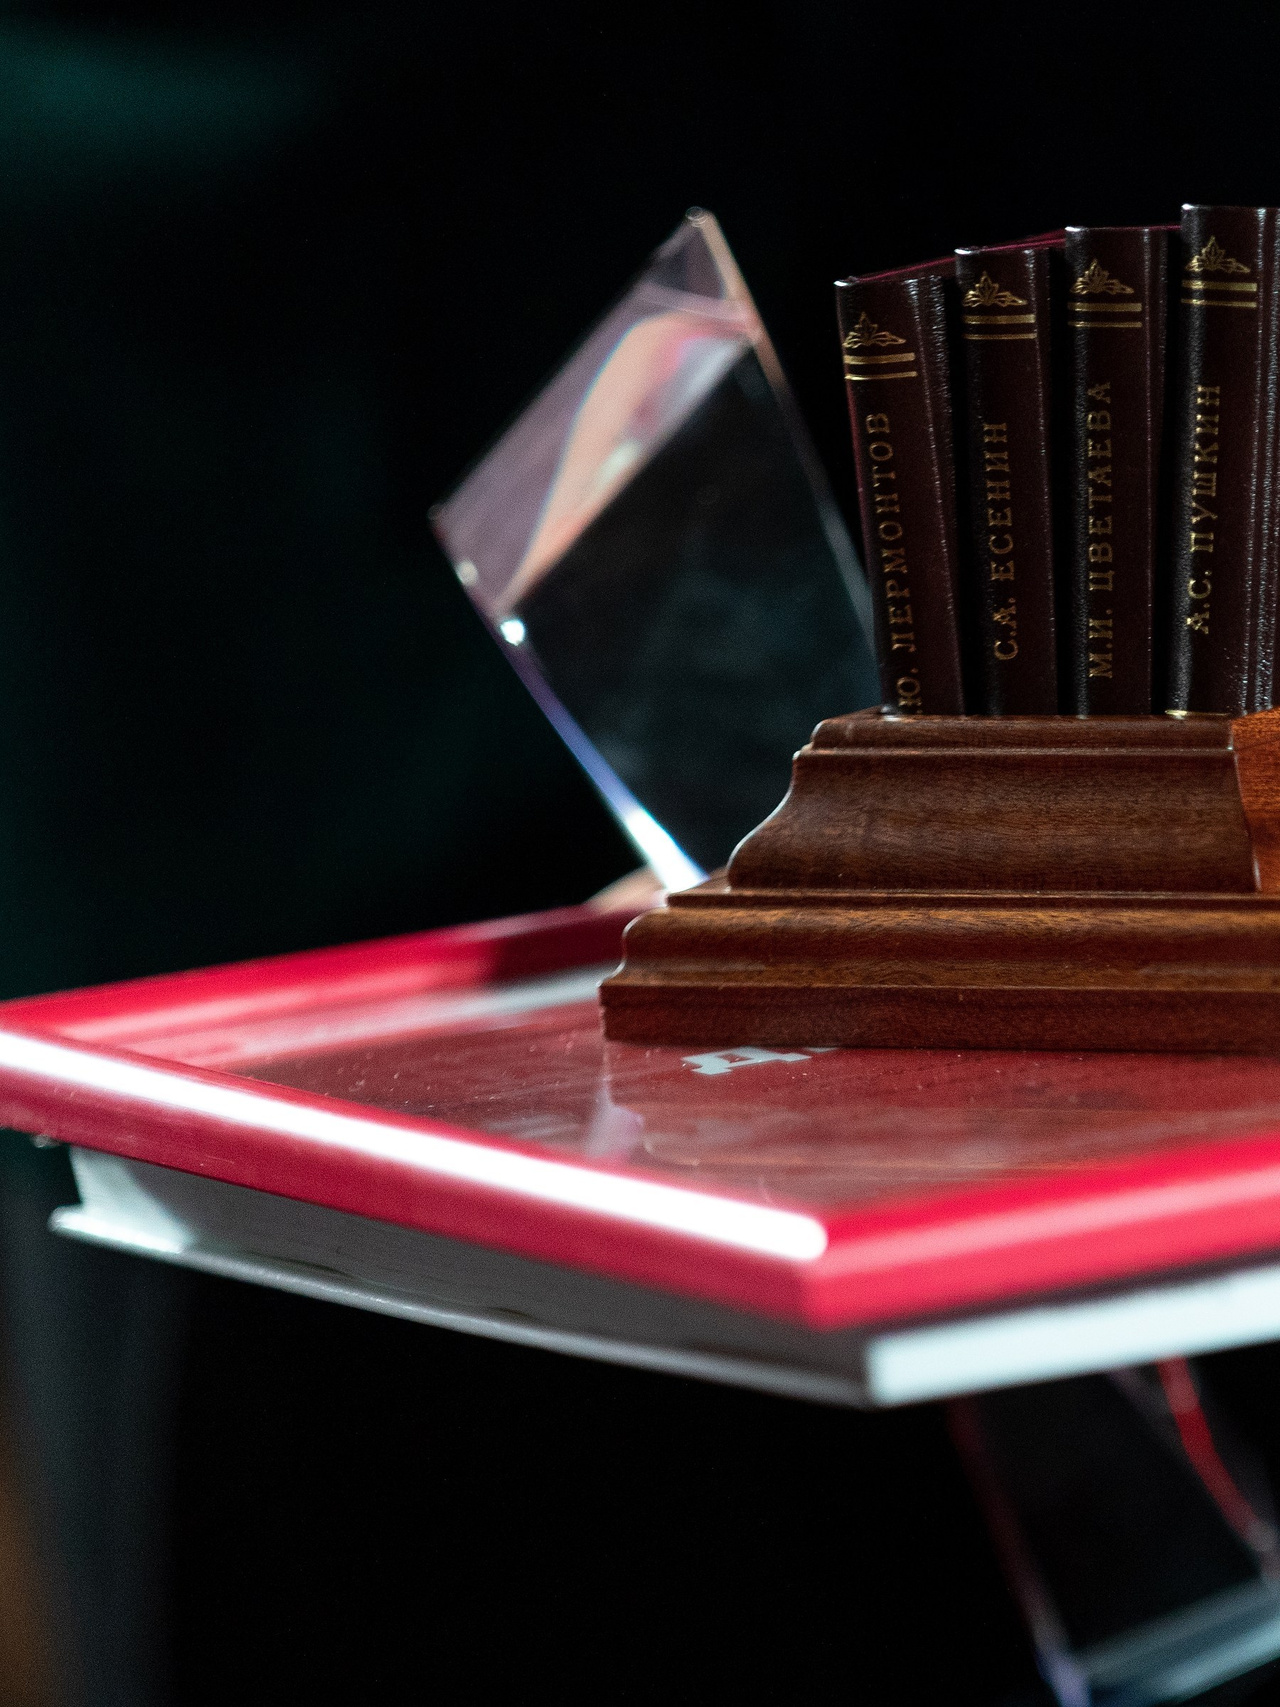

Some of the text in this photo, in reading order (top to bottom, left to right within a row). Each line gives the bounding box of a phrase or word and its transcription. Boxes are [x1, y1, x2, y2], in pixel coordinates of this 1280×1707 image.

[865, 411, 918, 654] ЛЕРМОНТОВ
[982, 421, 1019, 661] С.А. ЕСЕНИН
[1086, 380, 1115, 679] М.И. ЦВЕТАЕВА
[1186, 384, 1221, 635] А.С. ПУШКИН
